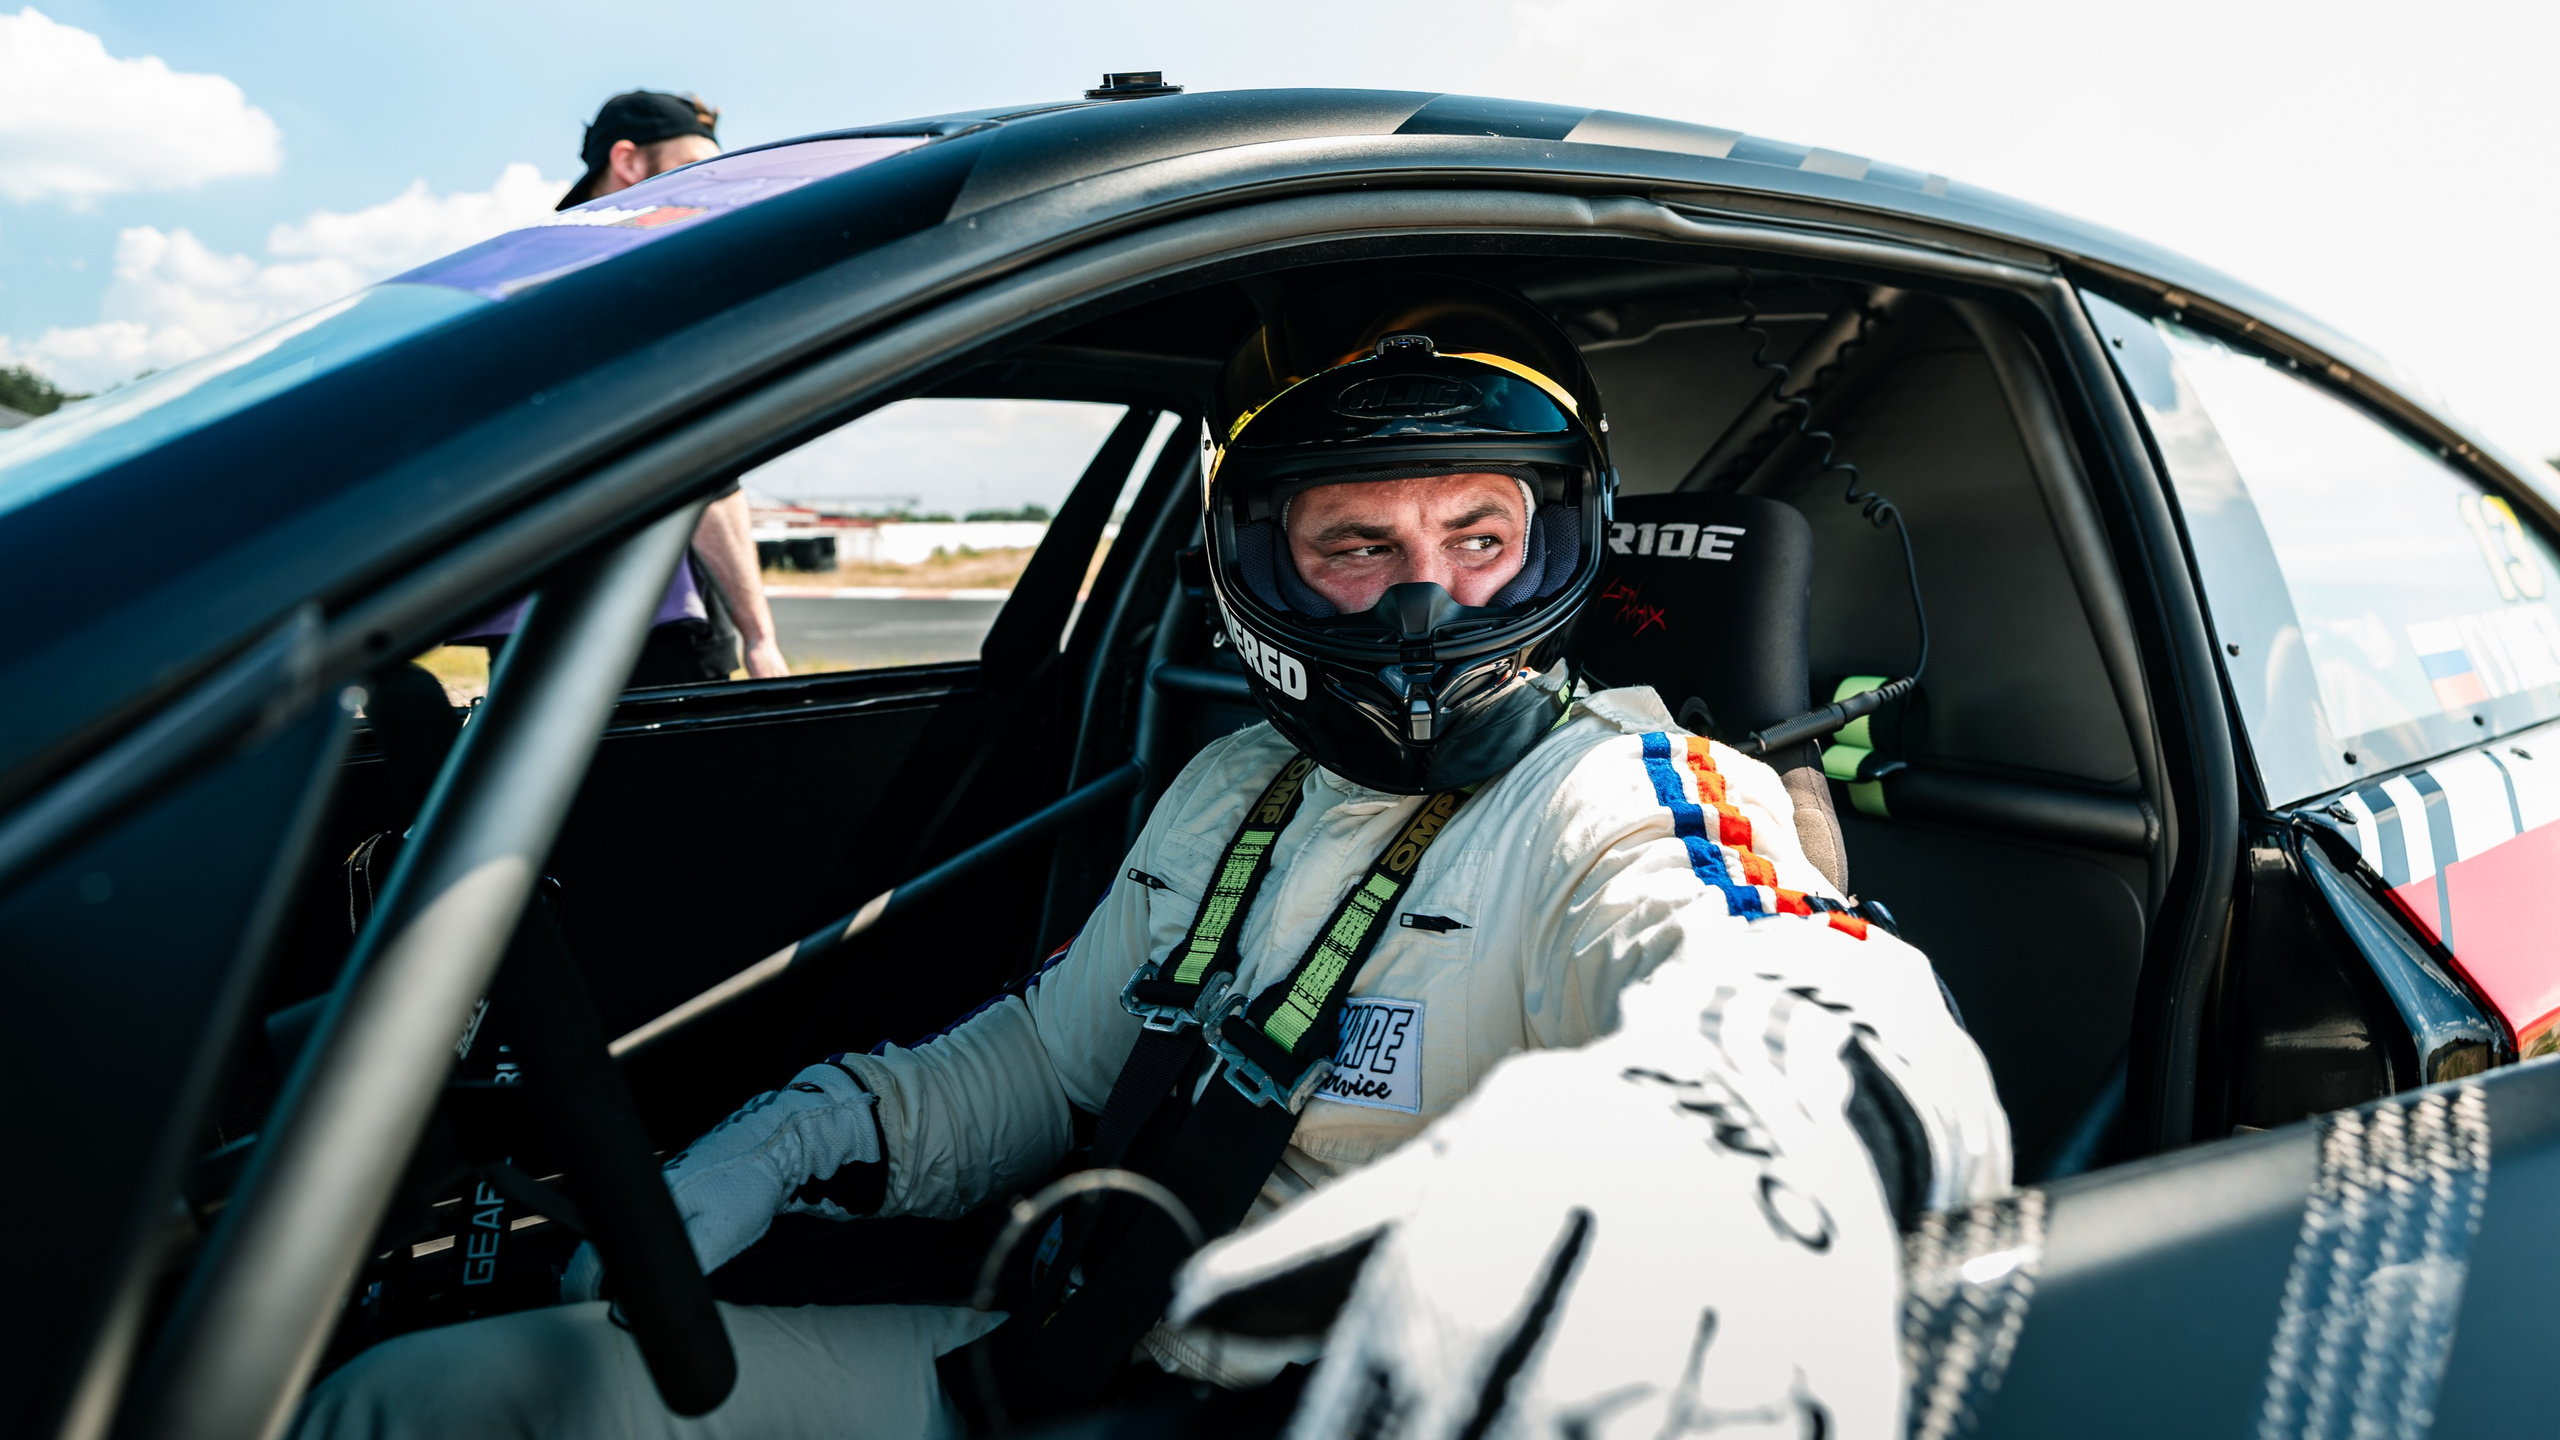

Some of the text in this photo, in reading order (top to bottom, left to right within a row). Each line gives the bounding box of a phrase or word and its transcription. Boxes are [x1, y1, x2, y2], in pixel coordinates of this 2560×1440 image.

[1608, 522, 1747, 561] RIDE
[2459, 494, 2545, 602] 13
[1262, 758, 1312, 824] OMP
[1390, 794, 1455, 871] OMP
[1334, 1004, 1414, 1074] HAPE
